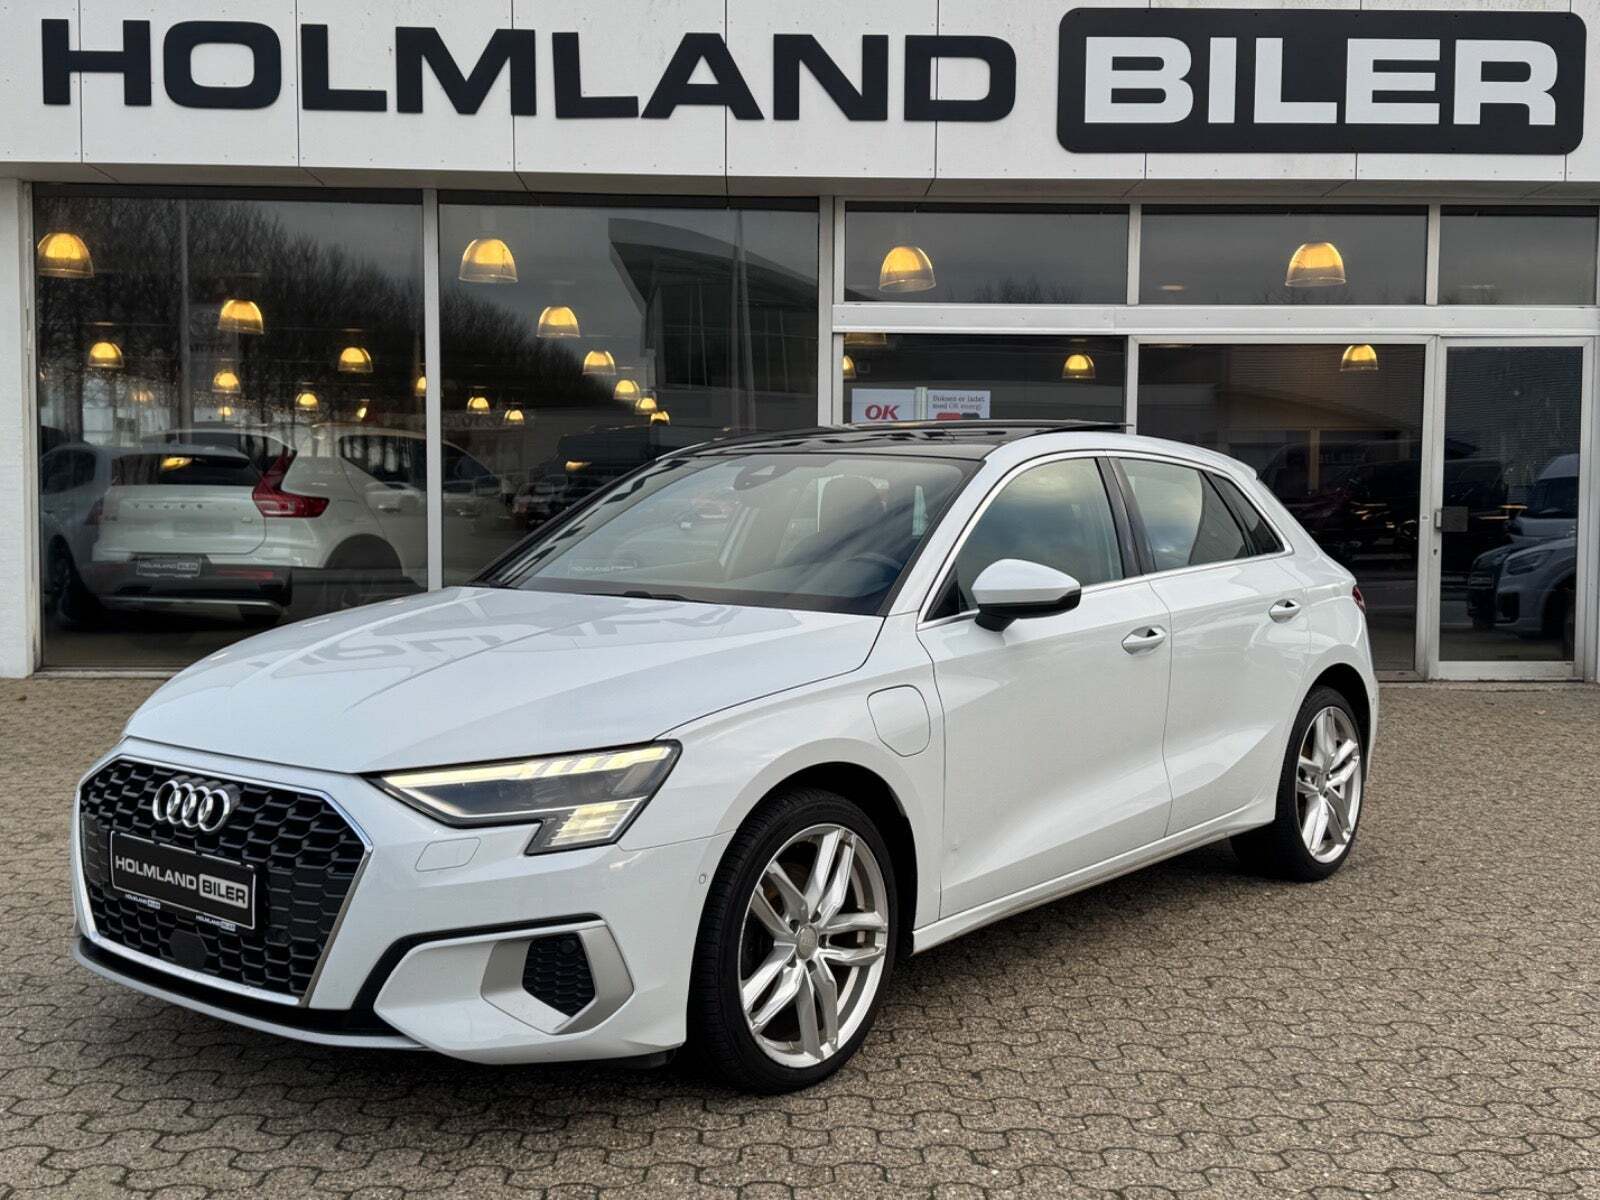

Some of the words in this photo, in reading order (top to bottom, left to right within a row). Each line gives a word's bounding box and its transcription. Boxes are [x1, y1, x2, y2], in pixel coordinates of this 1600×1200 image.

[41, 19, 1017, 122] HOLMLAND
[1084, 36, 1558, 126] BILER
[865, 404, 899, 420] OK
[115, 855, 197, 891] HOLMLAND
[202, 879, 247, 905] BILER
